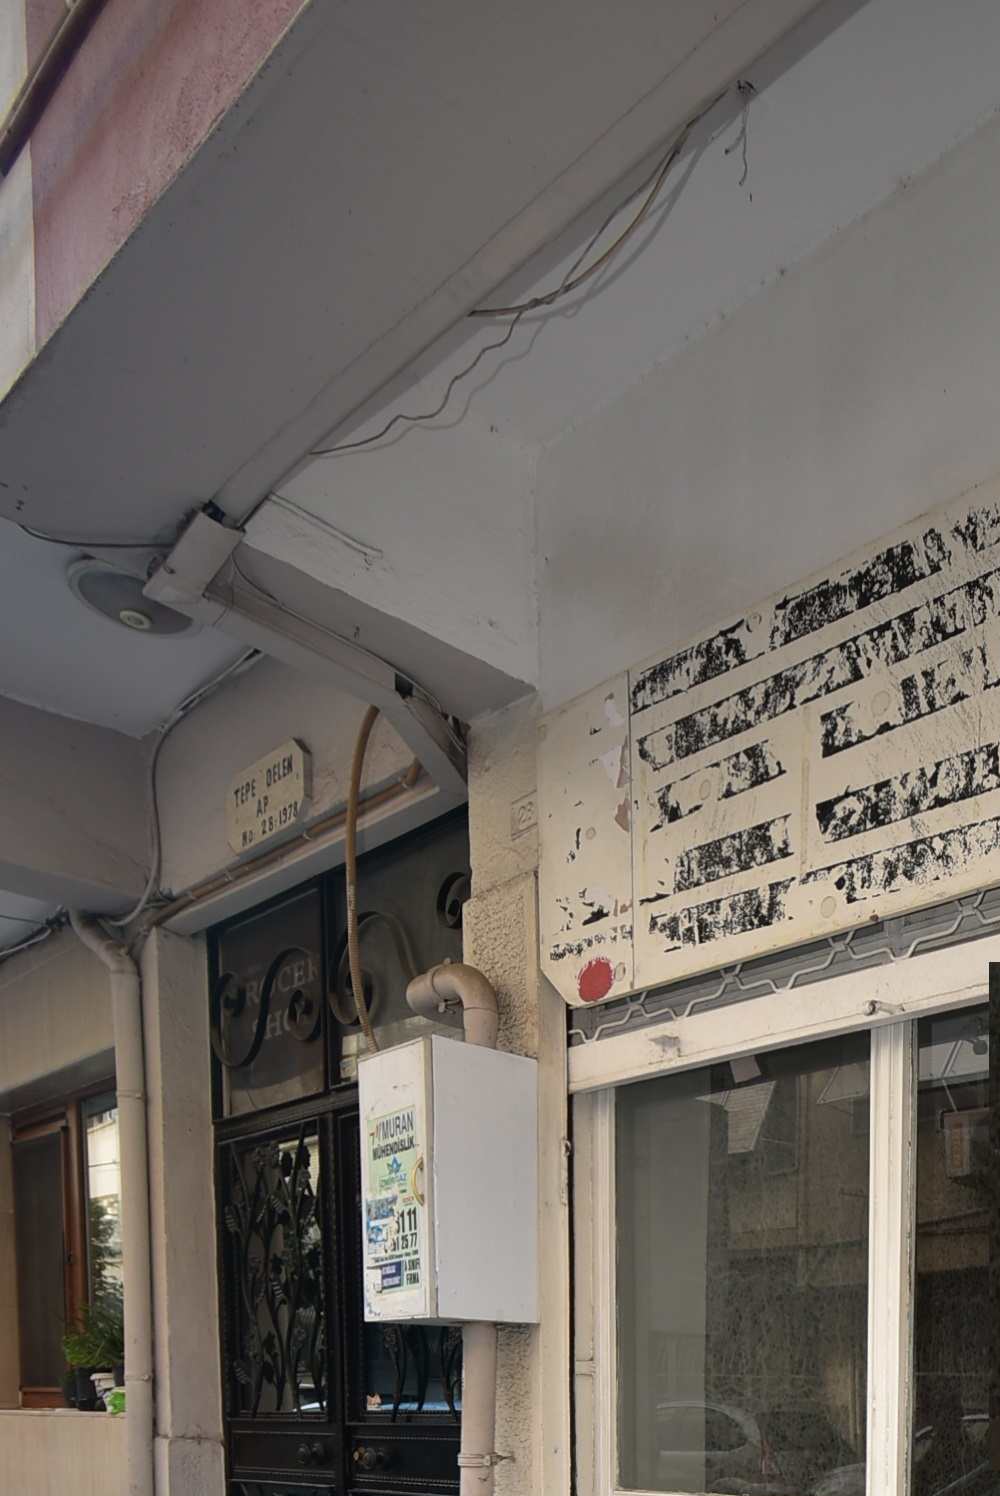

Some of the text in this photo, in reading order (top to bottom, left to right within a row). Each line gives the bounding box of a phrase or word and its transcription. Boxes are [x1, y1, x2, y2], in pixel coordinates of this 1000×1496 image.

[233, 754, 293, 808] TEPE DELEN
[256, 795, 269, 819] AP
[381, 1111, 414, 1141] MURAN
